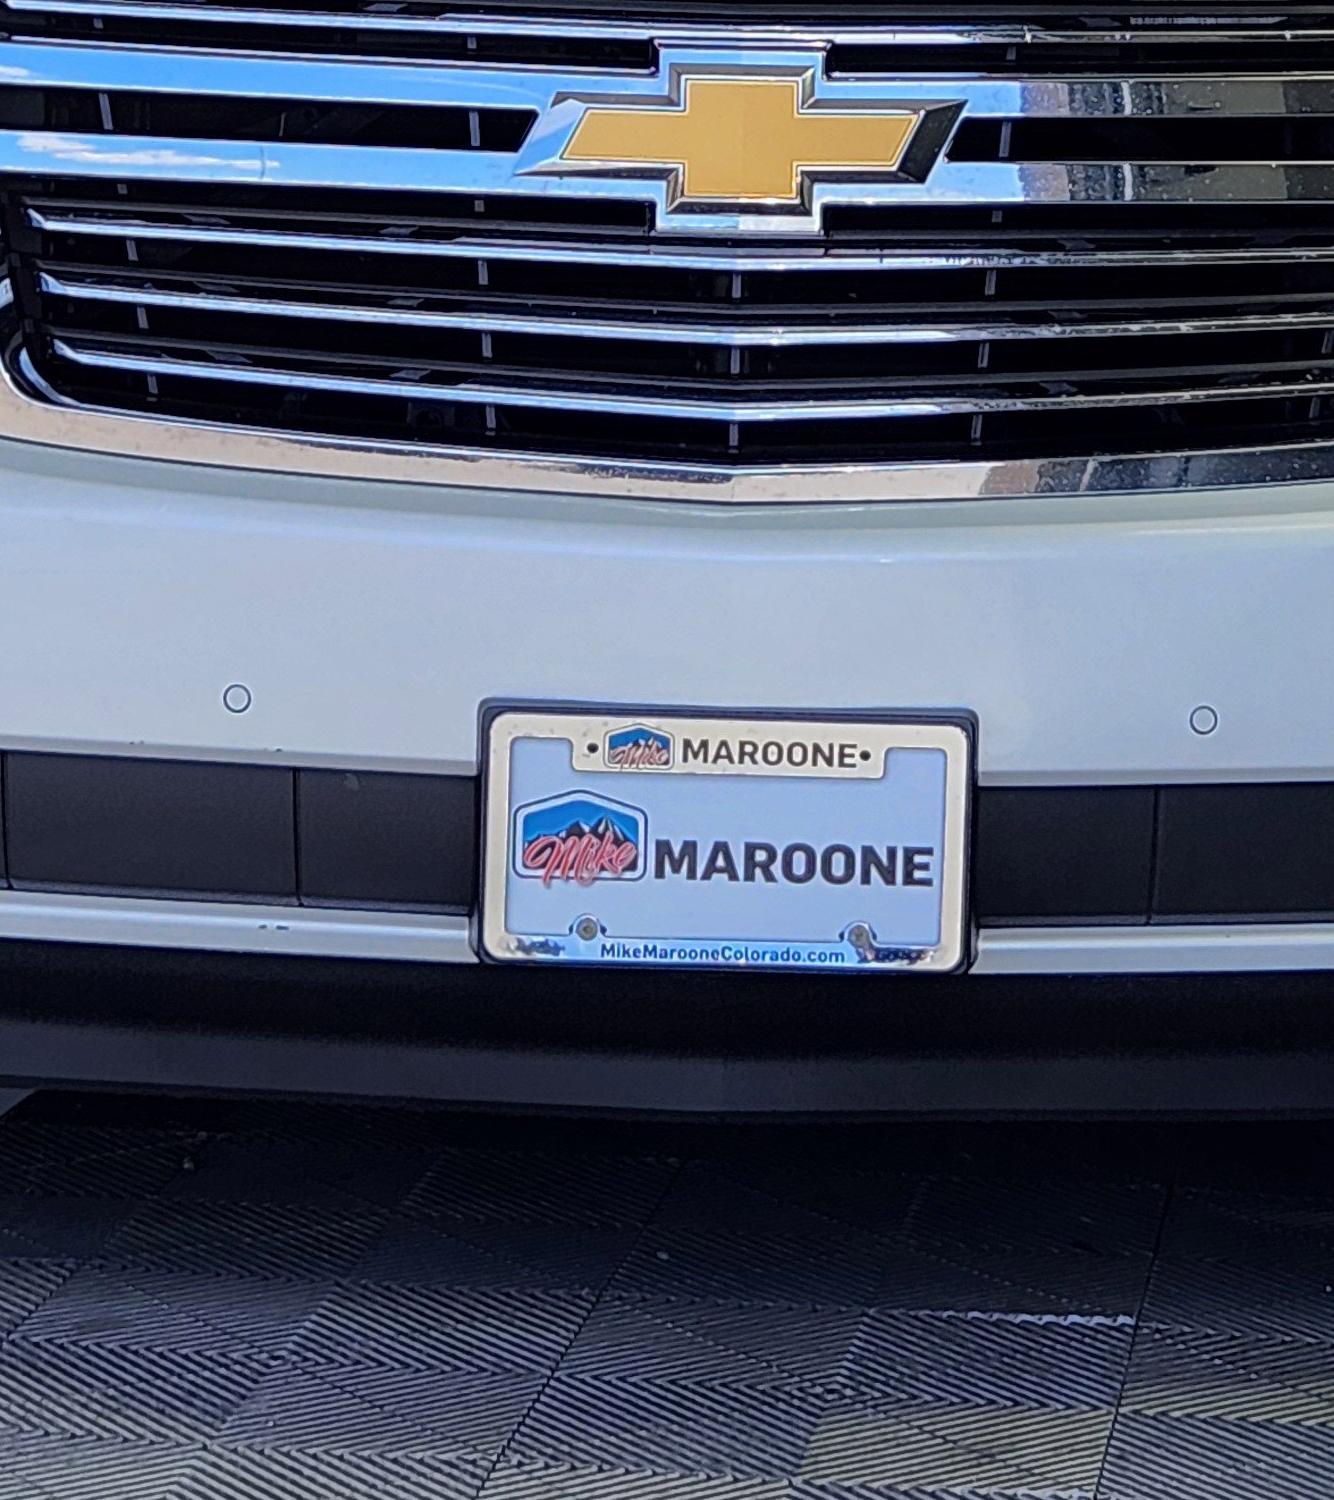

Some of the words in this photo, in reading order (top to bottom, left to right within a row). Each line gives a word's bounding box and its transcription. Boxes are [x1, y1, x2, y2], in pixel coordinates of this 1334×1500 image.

[681, 737, 858, 768] MAROONE
[523, 831, 639, 888] Mike
[654, 839, 935, 887] MAROONE
[599, 942, 846, 964] MikeMarooneColorado.com
